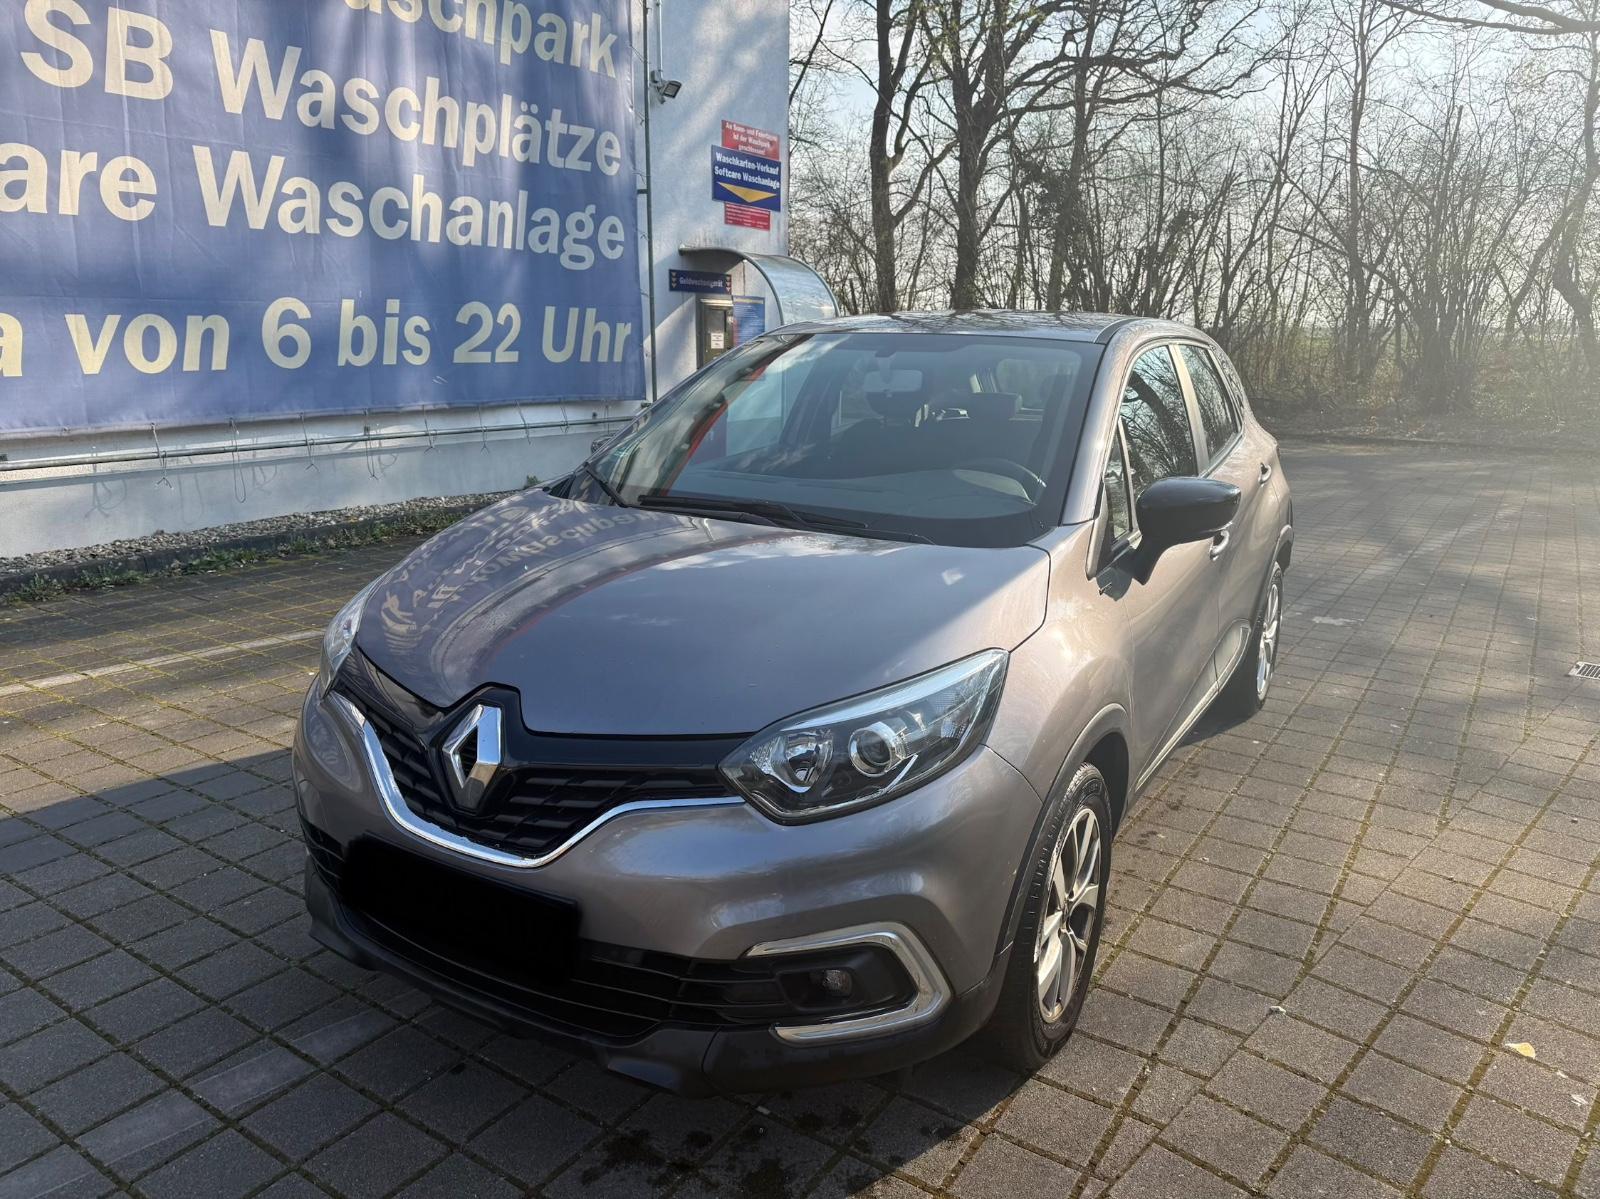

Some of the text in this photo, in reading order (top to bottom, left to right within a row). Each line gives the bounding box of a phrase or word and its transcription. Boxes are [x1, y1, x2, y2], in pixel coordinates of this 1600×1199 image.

[344, 0, 618, 79] chpark
[20, 0, 622, 177] SB Waschplätze
[714, 166, 780, 190] Softcare Waschanlage
[715, 152, 779, 176] Waschkarten-Verkauf
[193, 145, 625, 271] Waschanlage
[65, 313, 229, 376] von
[263, 297, 311, 369] 6
[338, 298, 431, 367] bis
[453, 303, 521, 364] 22
[543, 306, 631, 364] Uhr
